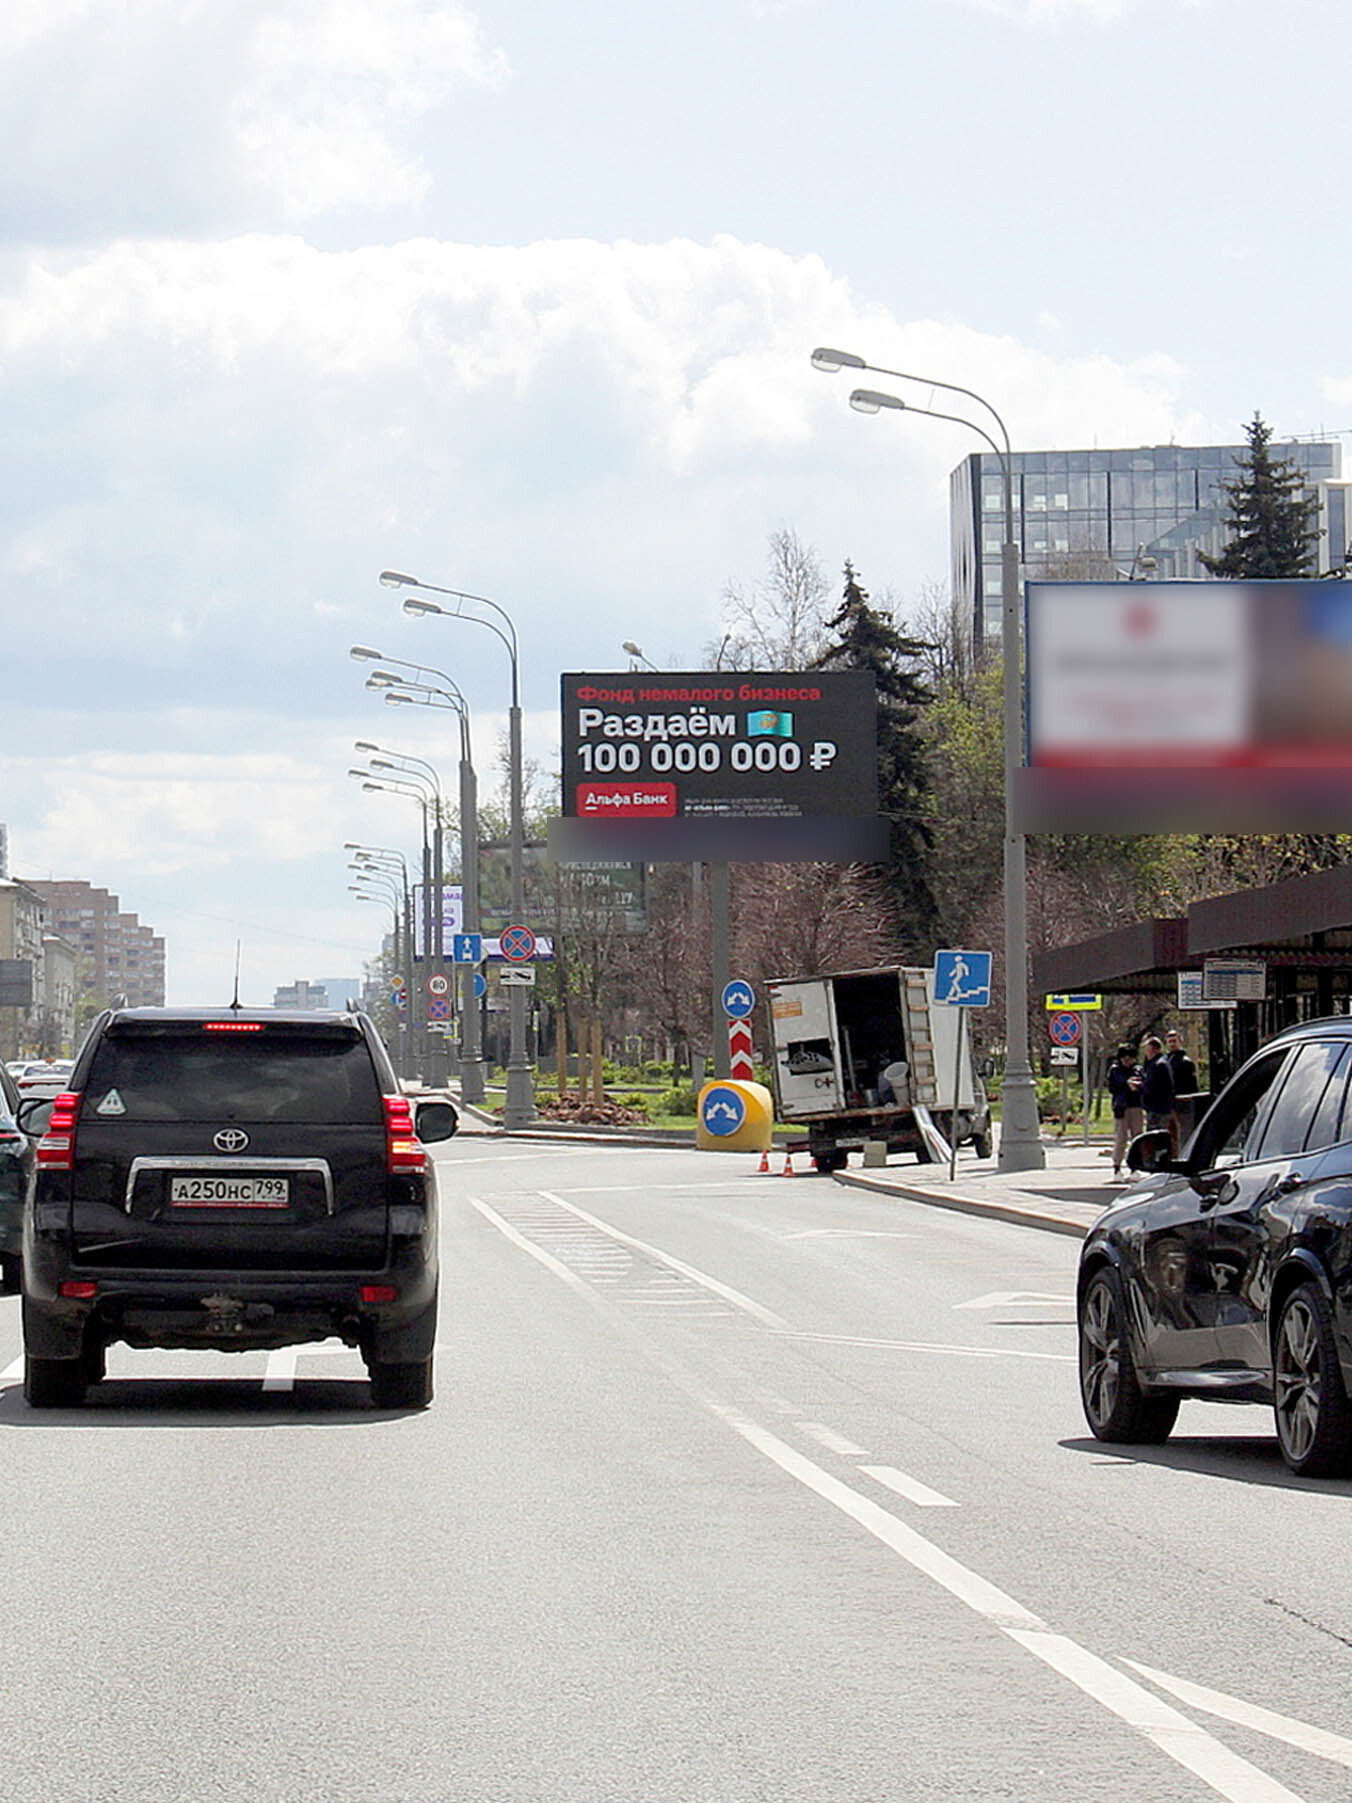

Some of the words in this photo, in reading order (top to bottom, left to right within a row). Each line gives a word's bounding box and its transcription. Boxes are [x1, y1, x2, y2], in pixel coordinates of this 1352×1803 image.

[577, 686, 635, 704] Фонд
[641, 687, 735, 702] немалого
[739, 684, 822, 701] бизнеса
[578, 706, 736, 741] Раздаём
[578, 742, 641, 772] 100
[650, 742, 721, 772] 000
[731, 742, 801, 772] 000
[585, 792, 631, 809] Альфа
[633, 792, 668, 805] Банк
[177, 1181, 252, 1199] А250НС
